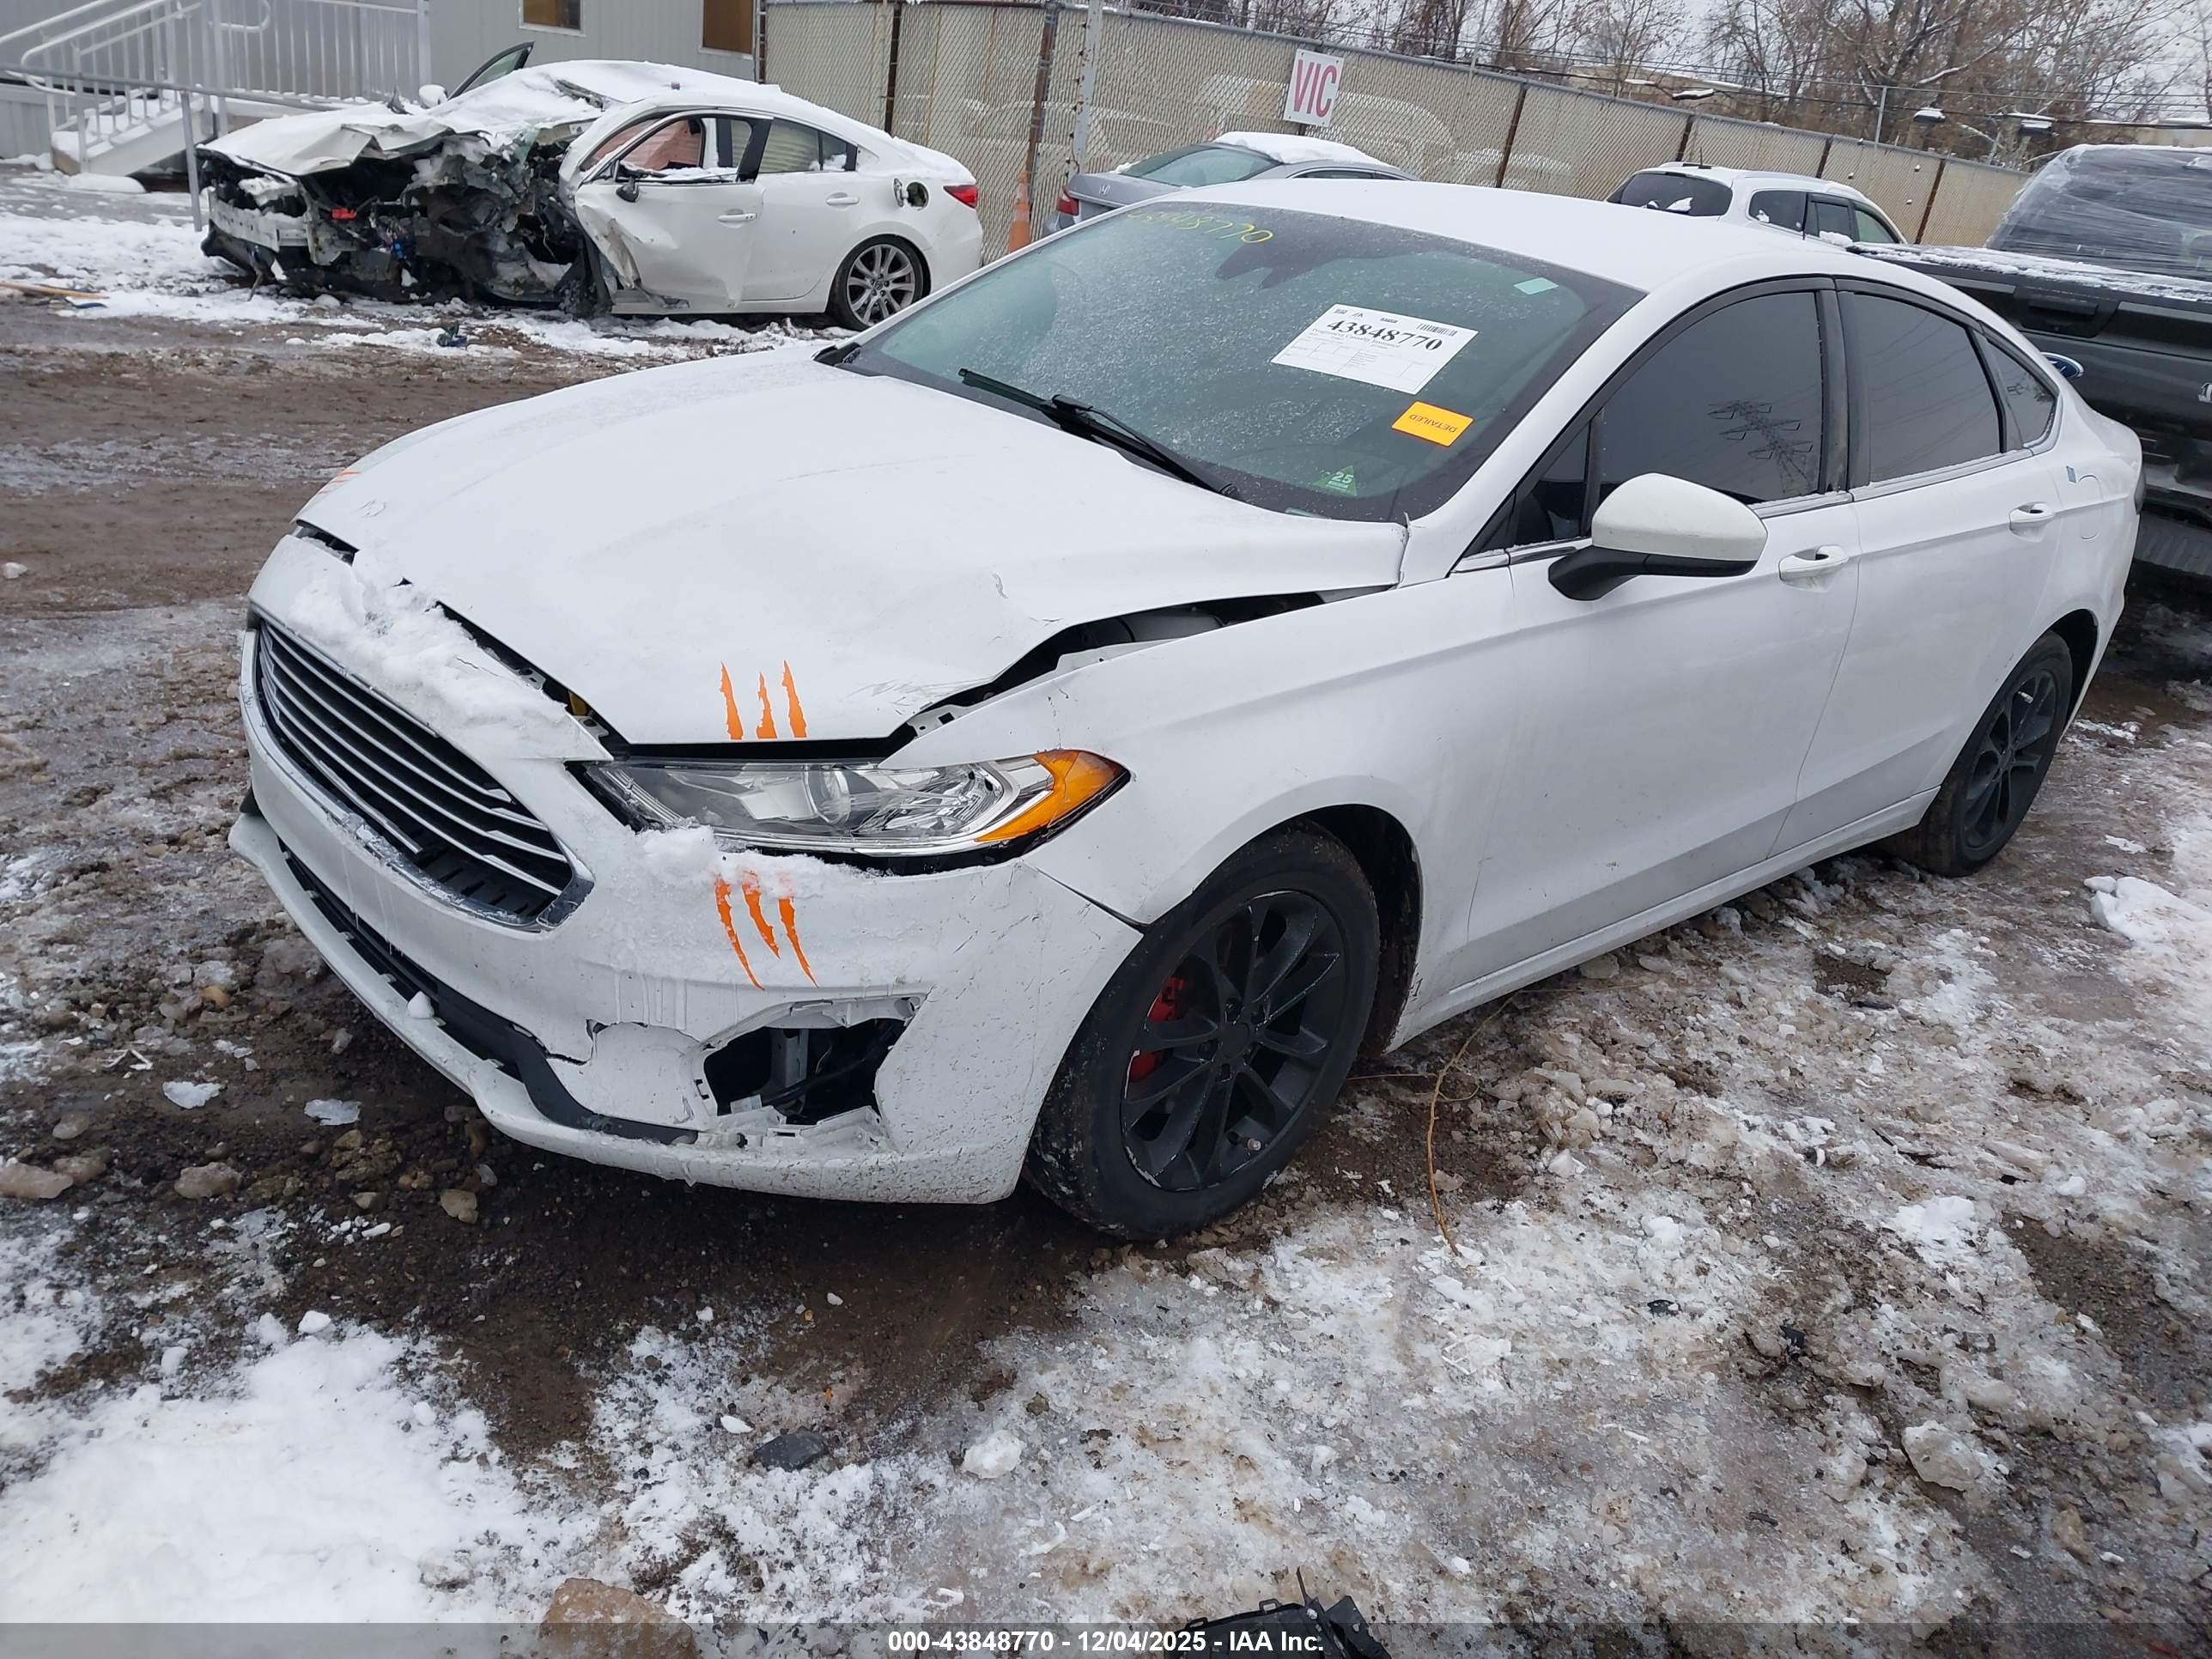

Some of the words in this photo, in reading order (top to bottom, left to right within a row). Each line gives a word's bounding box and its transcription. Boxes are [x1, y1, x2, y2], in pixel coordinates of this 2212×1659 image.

[1293, 59, 1337, 118] VIC
[1327, 319, 1443, 350] 43848770
[1409, 414, 1458, 433] DETAILED
[1332, 471, 1354, 483] 25
